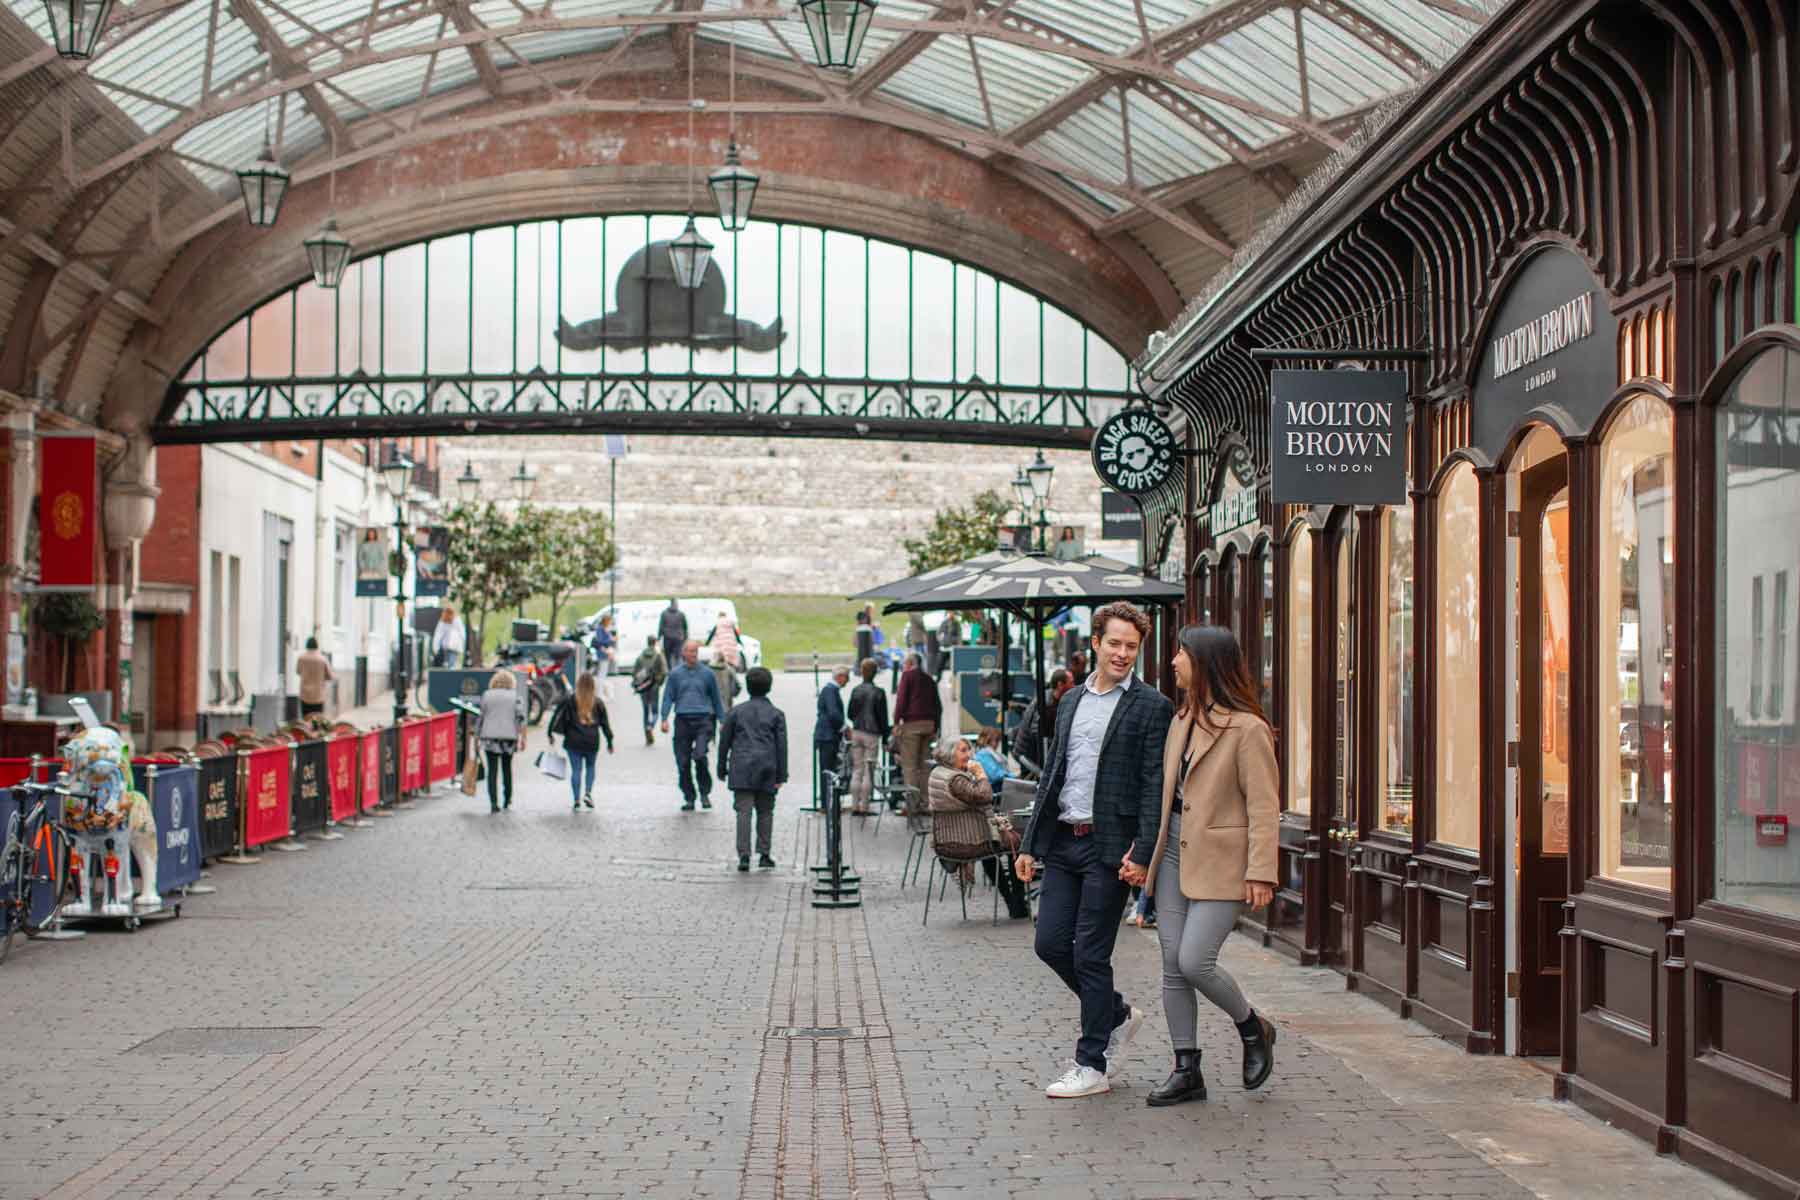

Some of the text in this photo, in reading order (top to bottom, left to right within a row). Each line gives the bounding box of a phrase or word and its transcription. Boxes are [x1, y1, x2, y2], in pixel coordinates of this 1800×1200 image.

[1494, 291, 1592, 379] MOLTON BROWN
[1525, 368, 1557, 392] LONDON
[1286, 401, 1393, 427] MOLTON
[1100, 415, 1170, 461] BLACK SHEEP
[1286, 431, 1393, 457] BROWN
[1118, 458, 1170, 489] COFFEE
[1306, 463, 1373, 473] LONDON
